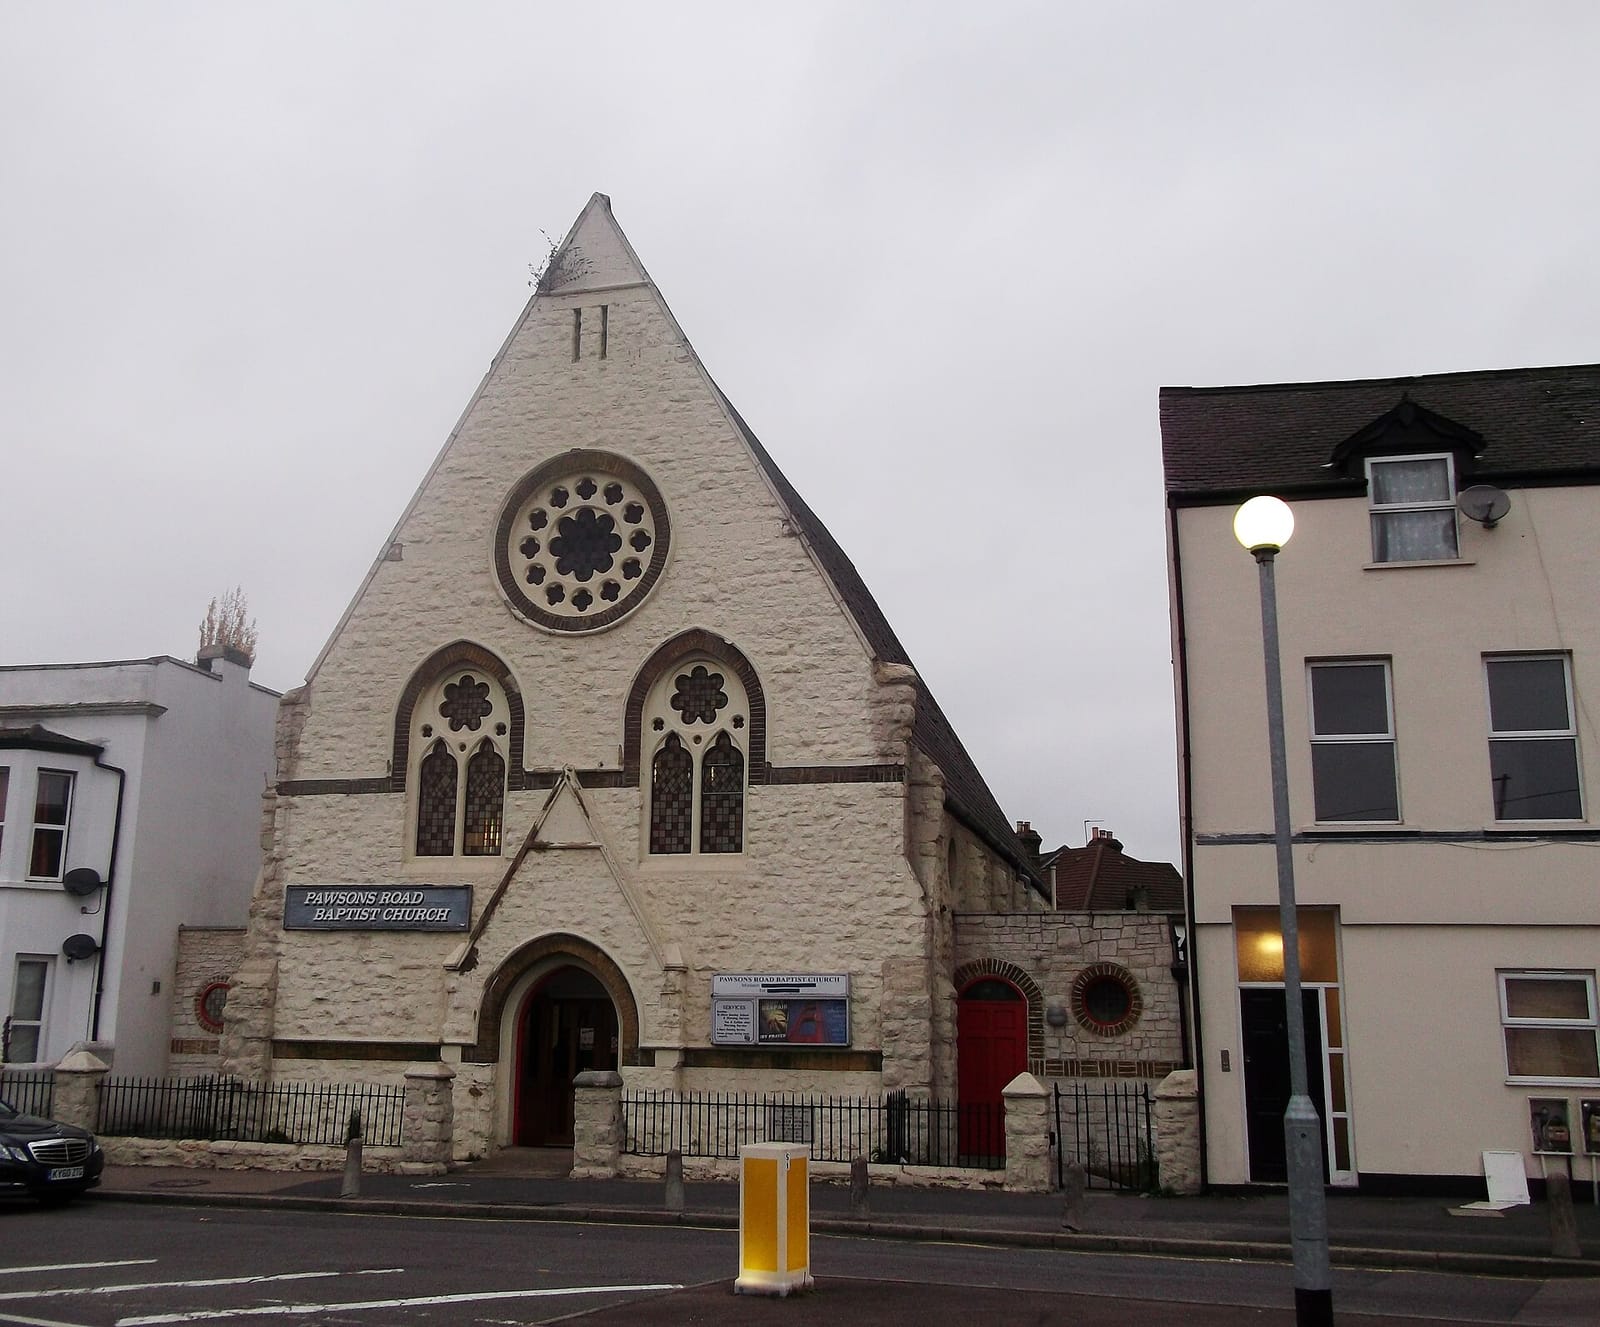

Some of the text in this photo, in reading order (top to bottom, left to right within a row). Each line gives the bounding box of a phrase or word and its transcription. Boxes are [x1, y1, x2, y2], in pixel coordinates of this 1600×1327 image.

[304, 891, 424, 905] PAWSONS ROAD
[313, 908, 450, 921] BAPTIST CHURCH
